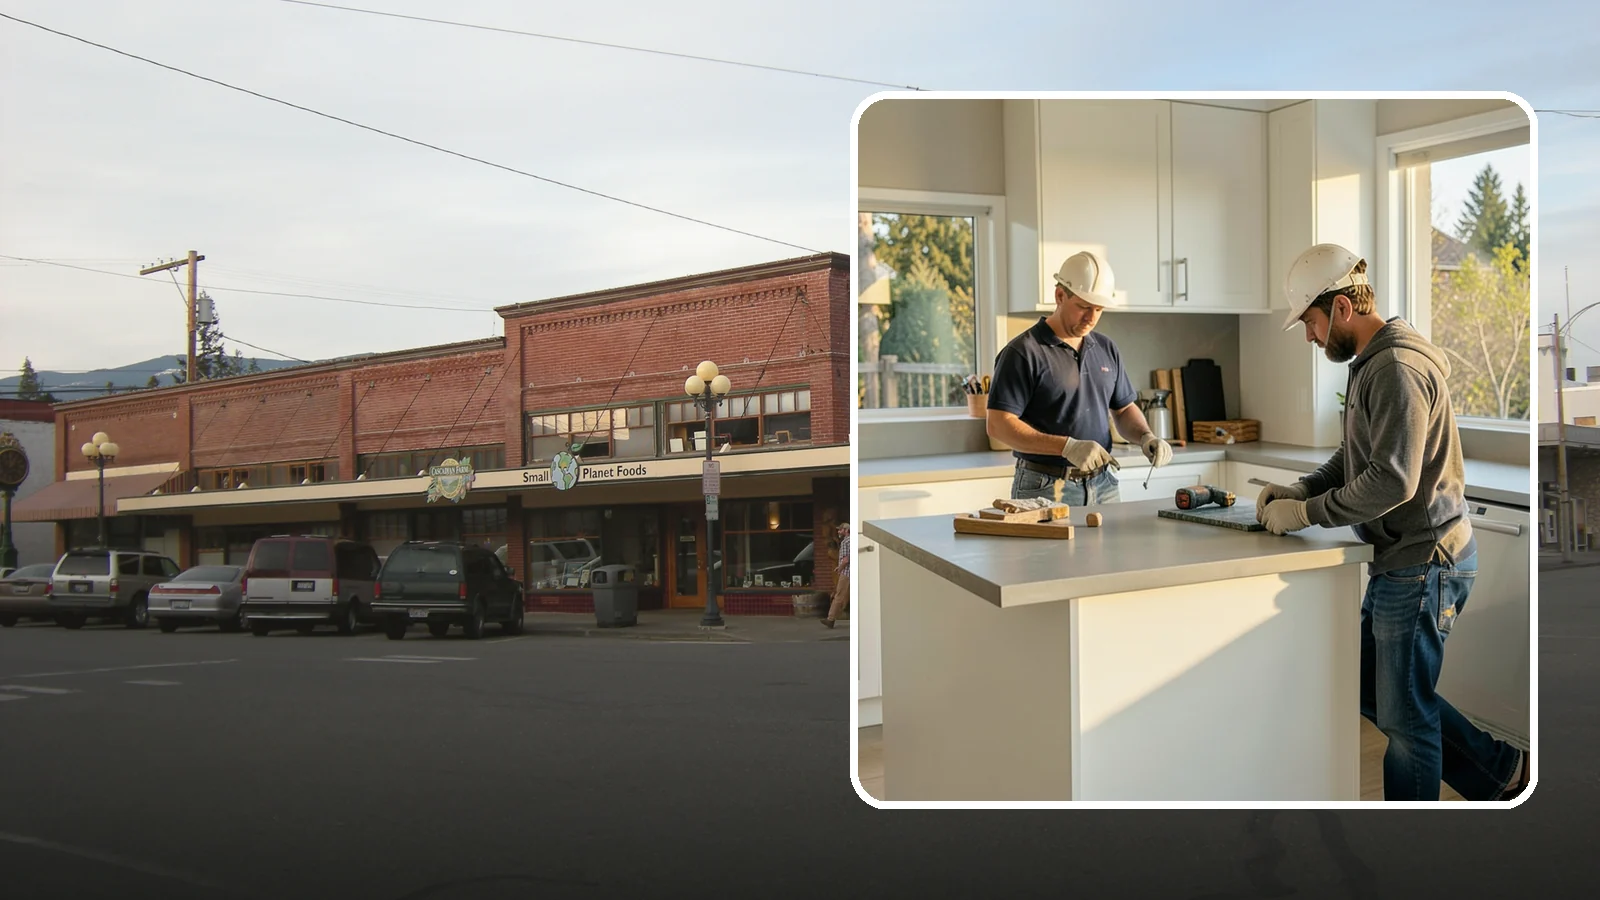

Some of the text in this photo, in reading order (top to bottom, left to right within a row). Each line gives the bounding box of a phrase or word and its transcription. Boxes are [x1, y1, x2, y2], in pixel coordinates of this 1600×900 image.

[523, 464, 647, 483] Small Planet Foods
